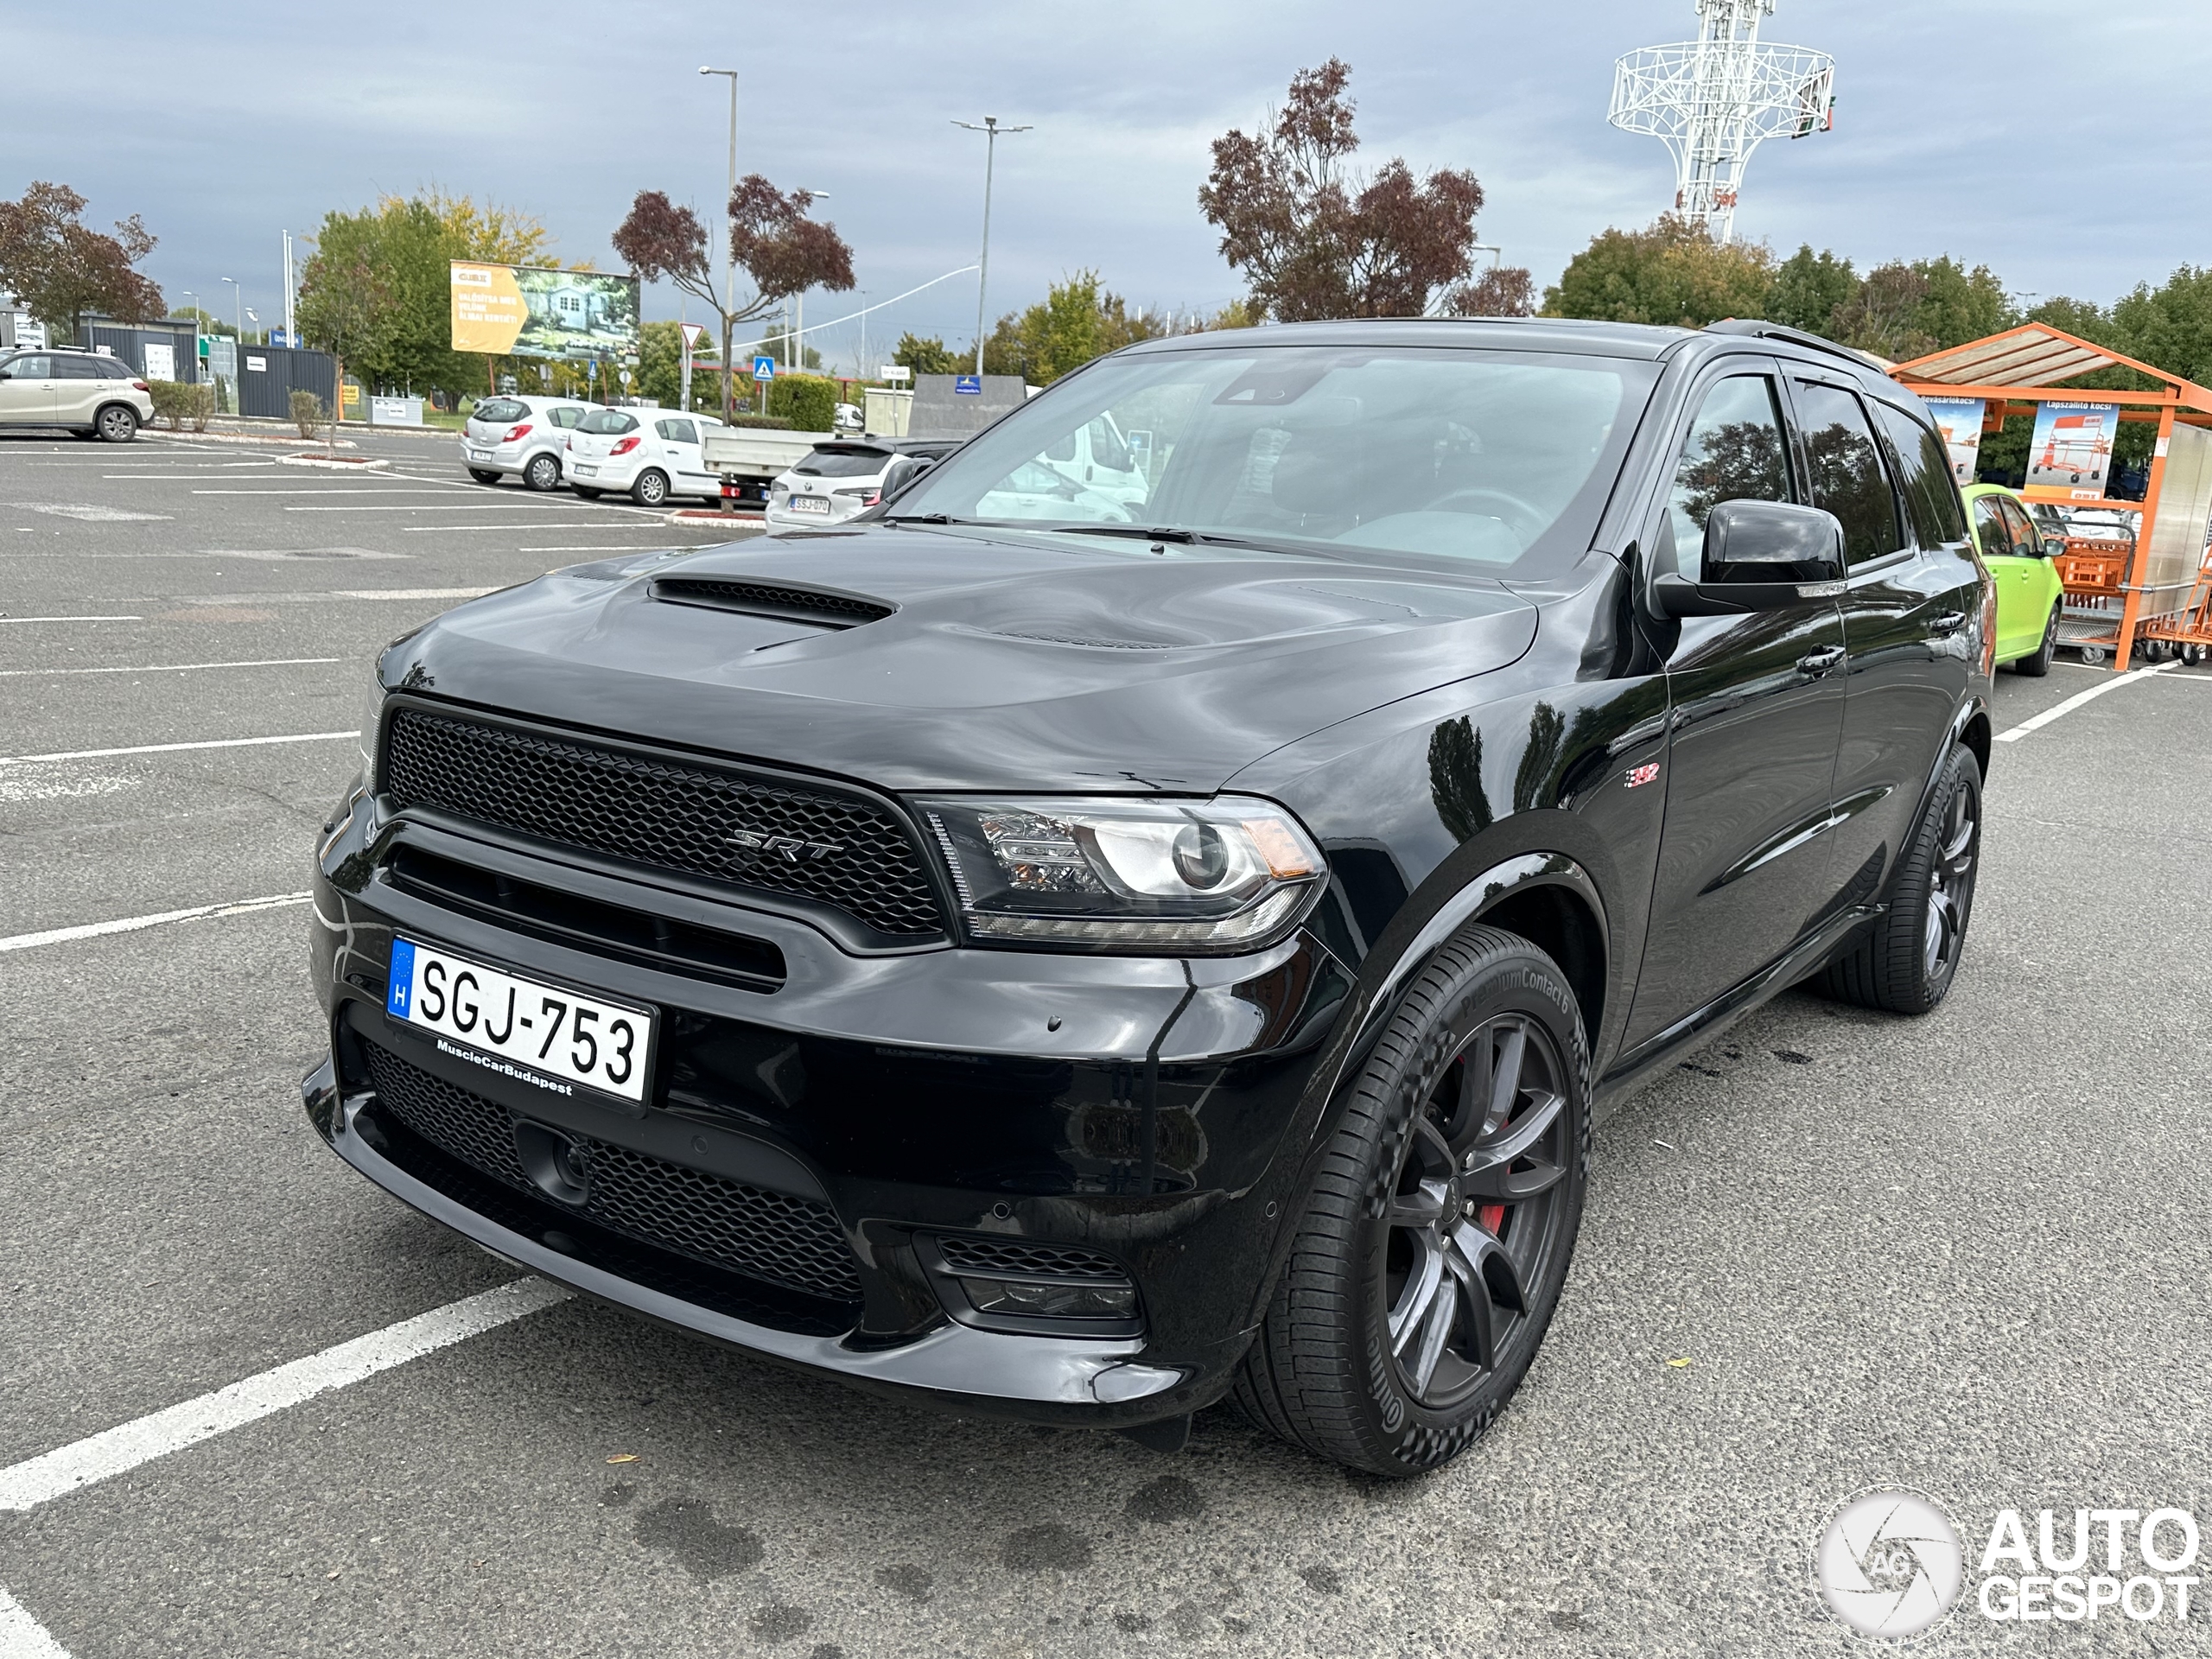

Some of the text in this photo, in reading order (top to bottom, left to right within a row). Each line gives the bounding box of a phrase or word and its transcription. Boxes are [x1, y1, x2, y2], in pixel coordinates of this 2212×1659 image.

[796, 499, 827, 511] SSJ-070
[725, 830, 845, 862] SRT
[394, 983, 407, 1007] H
[1560, 994, 1569, 1014] 6
[420, 959, 635, 1085] SGJ-753
[436, 1038, 573, 1097] MuscleCarBudapest
[1360, 1273, 1406, 1434] Continental
